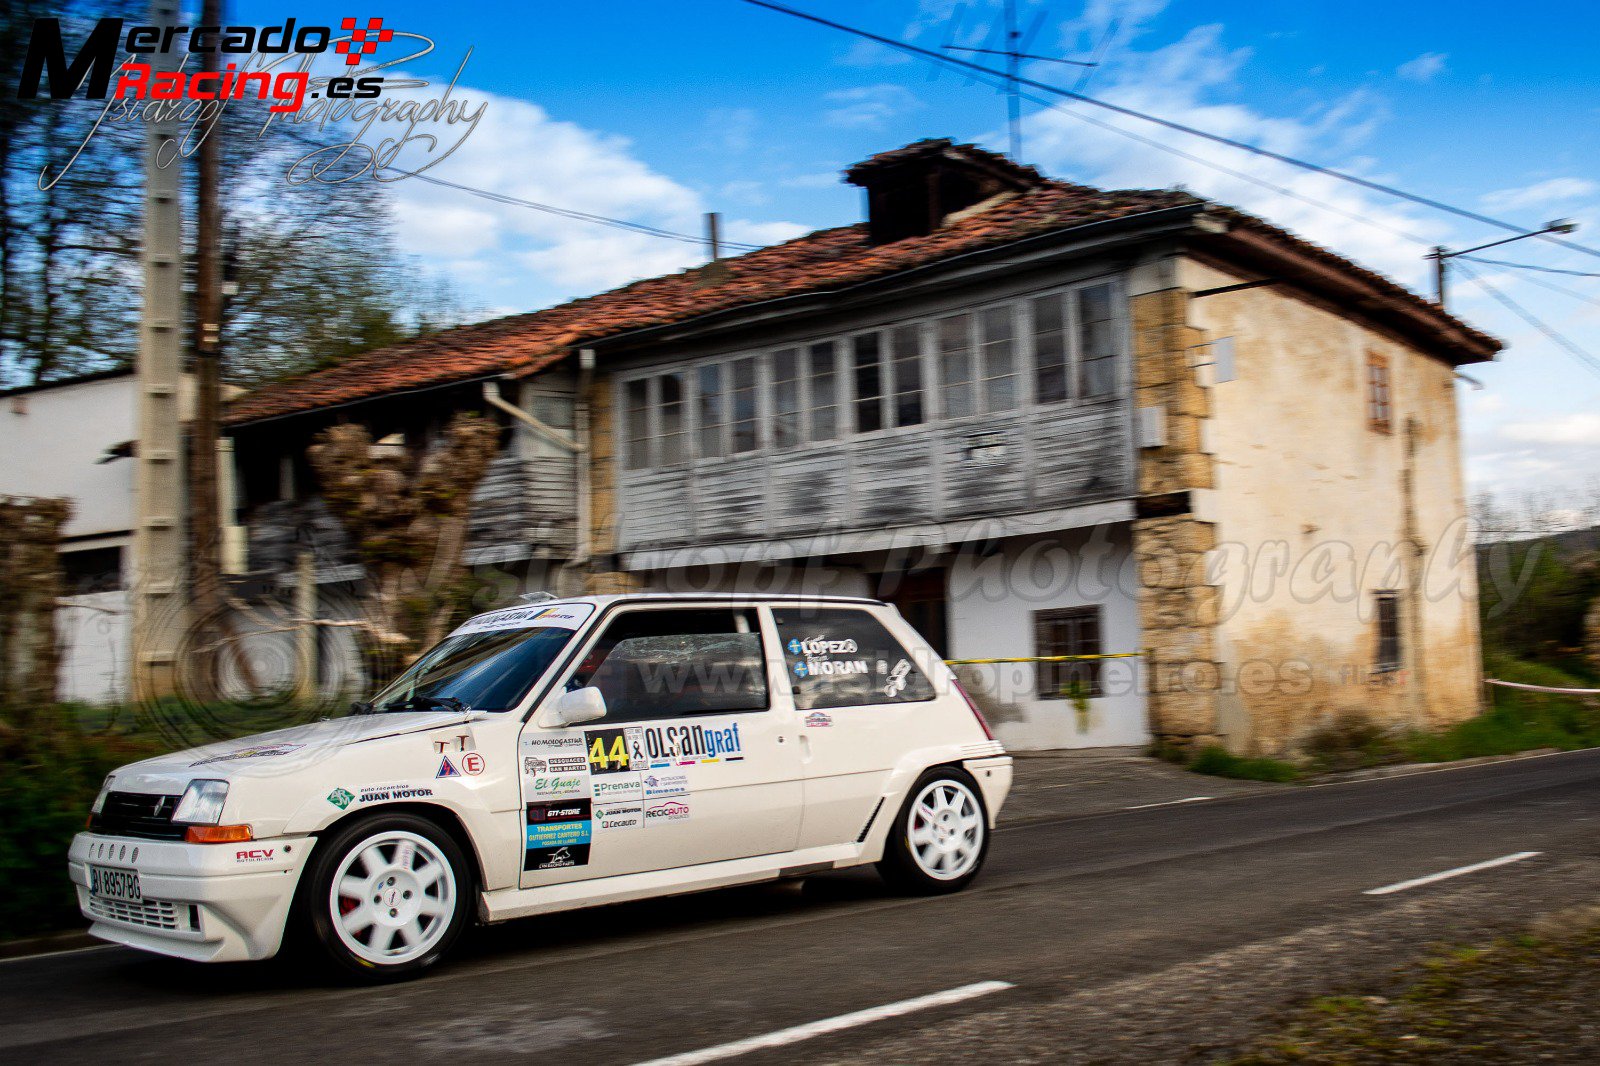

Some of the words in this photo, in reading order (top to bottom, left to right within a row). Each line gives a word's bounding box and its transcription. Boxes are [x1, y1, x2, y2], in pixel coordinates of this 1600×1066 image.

[807, 660, 869, 675] MORAN
[589, 735, 629, 769] 44
[535, 778, 547, 790] El
[551, 777, 581, 791] Guaje
[601, 781, 640, 791] Prenava
[359, 791, 390, 802] JUAN
[393, 789, 433, 799] MOTOR
[646, 806, 689, 818] RECICAUTO
[537, 823, 583, 832] TRANSPORTES
[609, 819, 637, 828] Cecauto
[529, 833, 557, 841] GUTIERREZ
